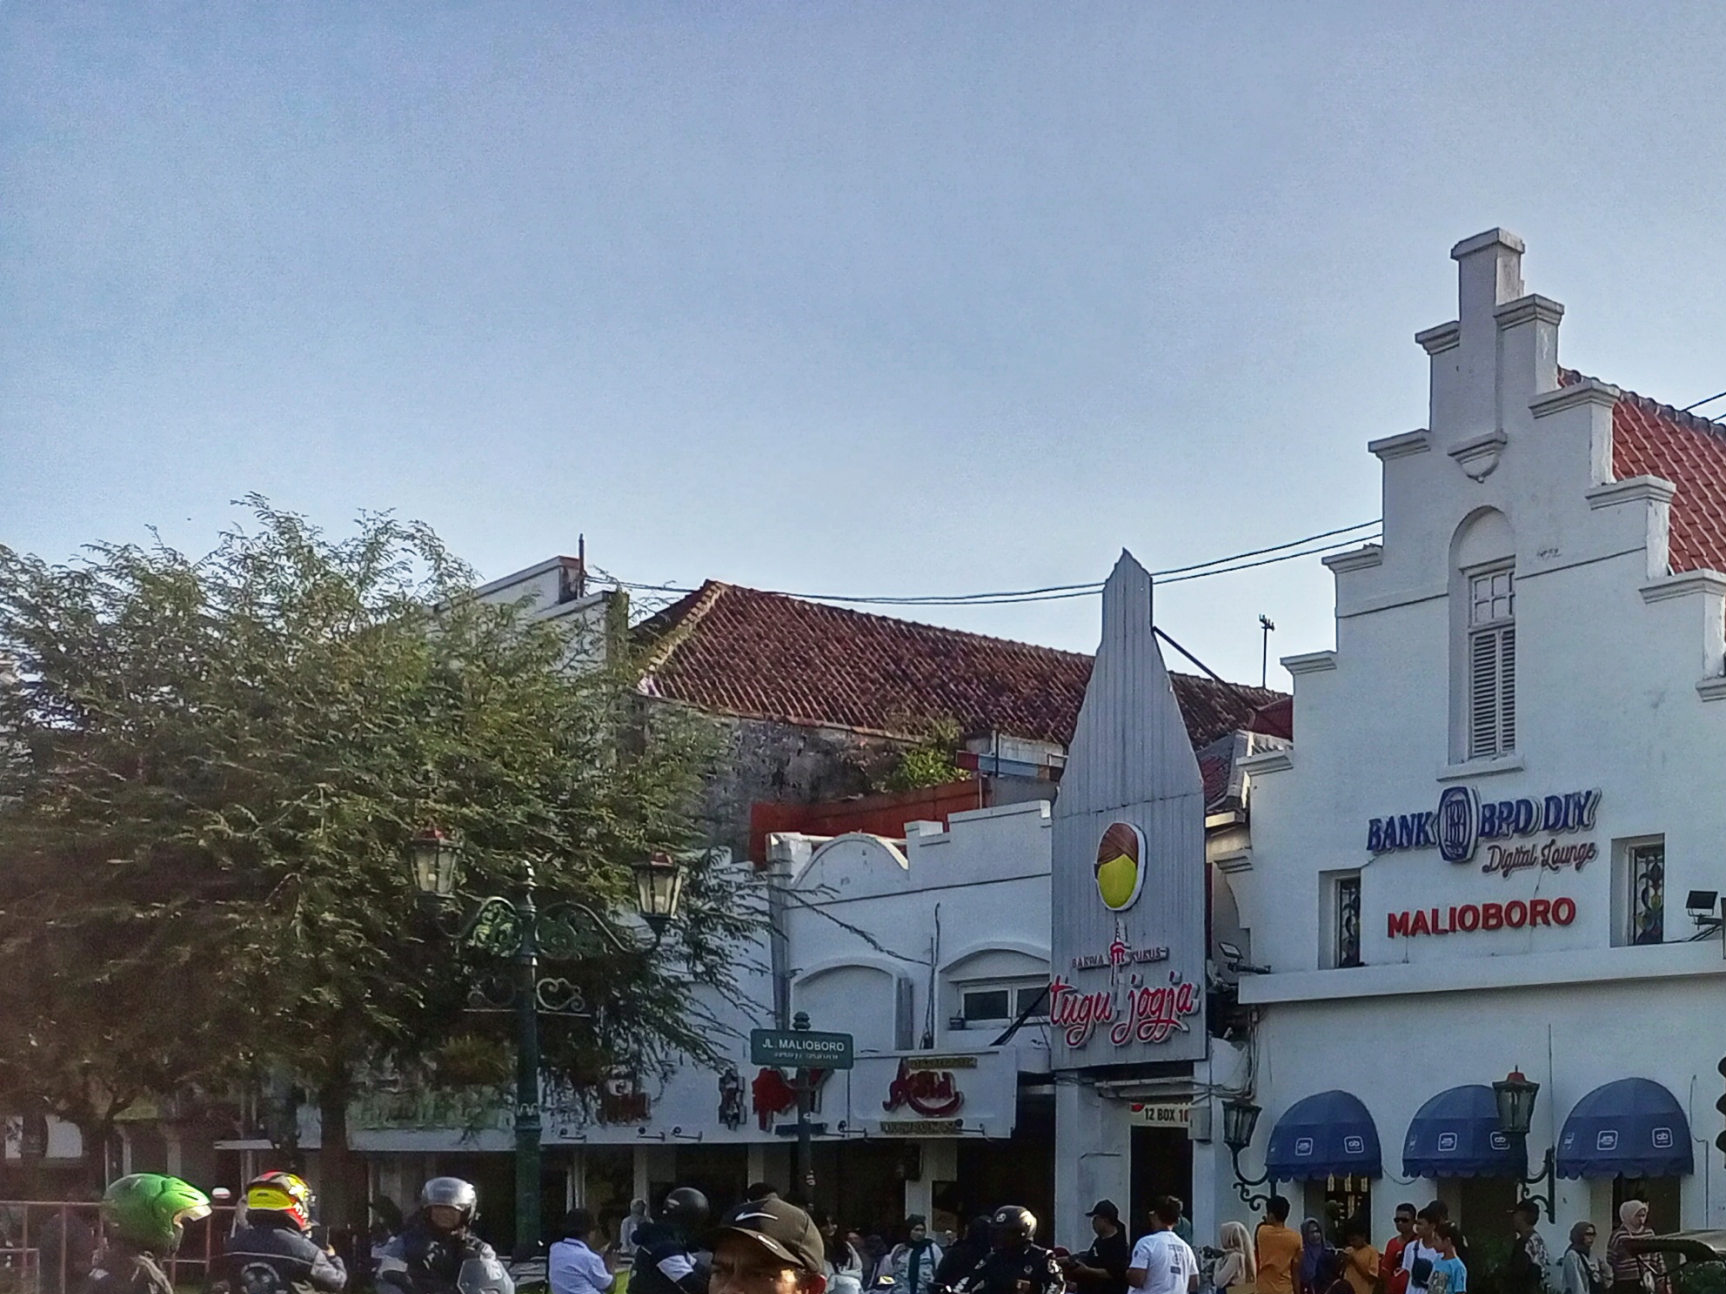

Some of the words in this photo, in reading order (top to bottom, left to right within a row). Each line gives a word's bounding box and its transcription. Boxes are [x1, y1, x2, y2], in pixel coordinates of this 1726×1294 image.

[1366, 810, 1436, 852] BANK
[1479, 799, 1535, 838] BPD
[1543, 789, 1597, 831] DIY
[1482, 843, 1537, 877] Digital
[1541, 839, 1597, 872] Lounge
[1387, 897, 1577, 939] MALIOBORO
[1051, 975, 1113, 1047] tugu
[1111, 970, 1193, 1046] jogja
[779, 1039, 845, 1052] MALIOBORO
[1144, 1107, 1155, 1121] 12
[1157, 1108, 1176, 1122] BOX
